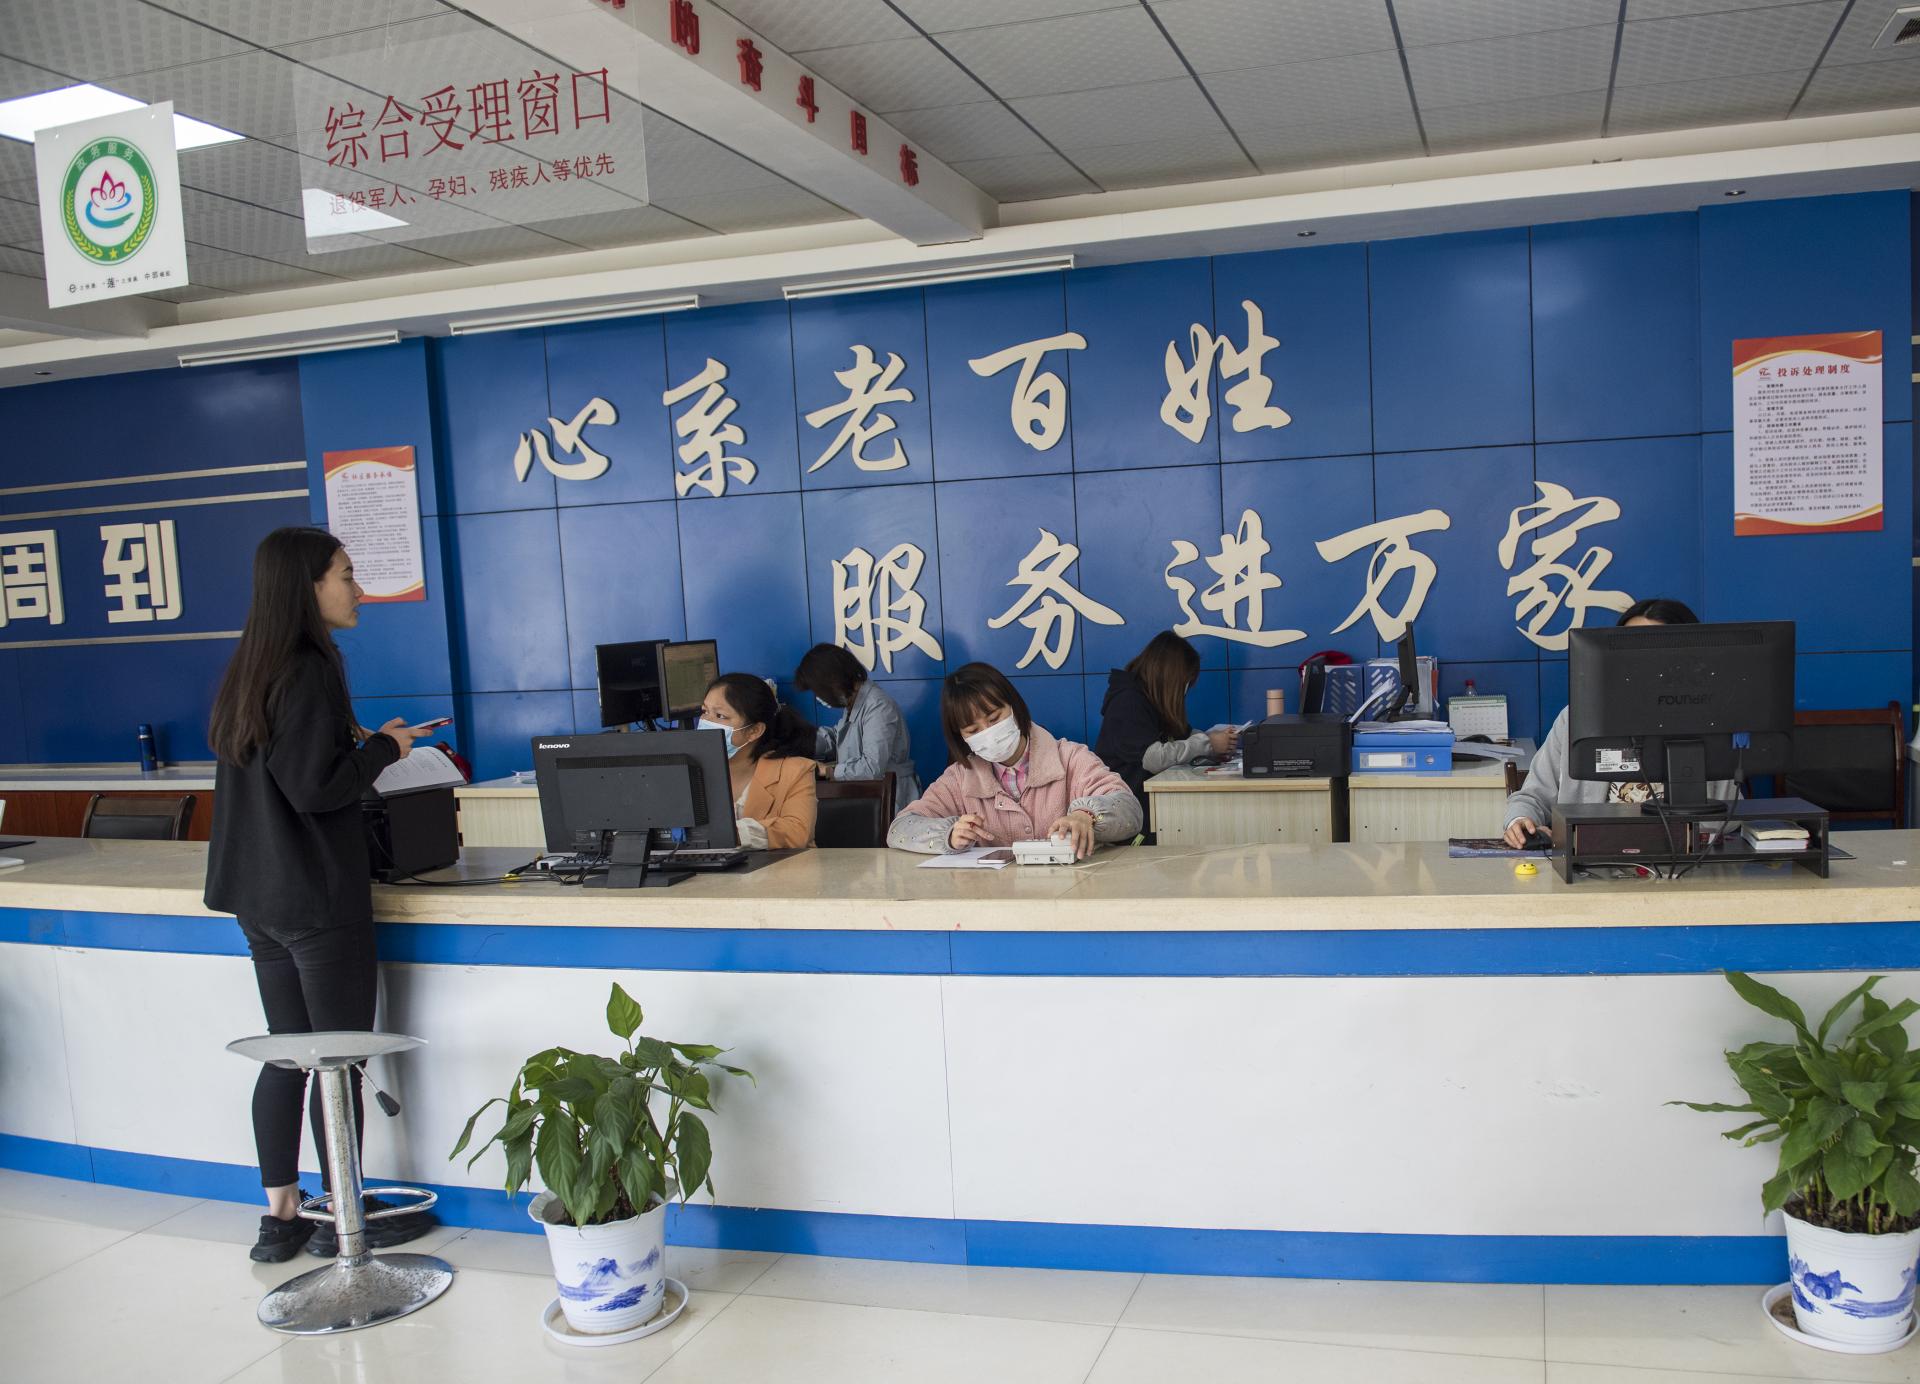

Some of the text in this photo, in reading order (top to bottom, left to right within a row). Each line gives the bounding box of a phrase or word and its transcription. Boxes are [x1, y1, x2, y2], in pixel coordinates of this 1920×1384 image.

[75, 141, 134, 172] 政务服务
[325, 66, 612, 169] 综合受理窗口
[329, 153, 616, 217] 退役军人、孕妇、残疾人等优先
[514, 299, 1292, 498] 心系老百姓
[1777, 364, 1850, 377] 投诉处理制度
[0, 519, 183, 628] 周到
[831, 481, 1636, 674] 服务进万家
